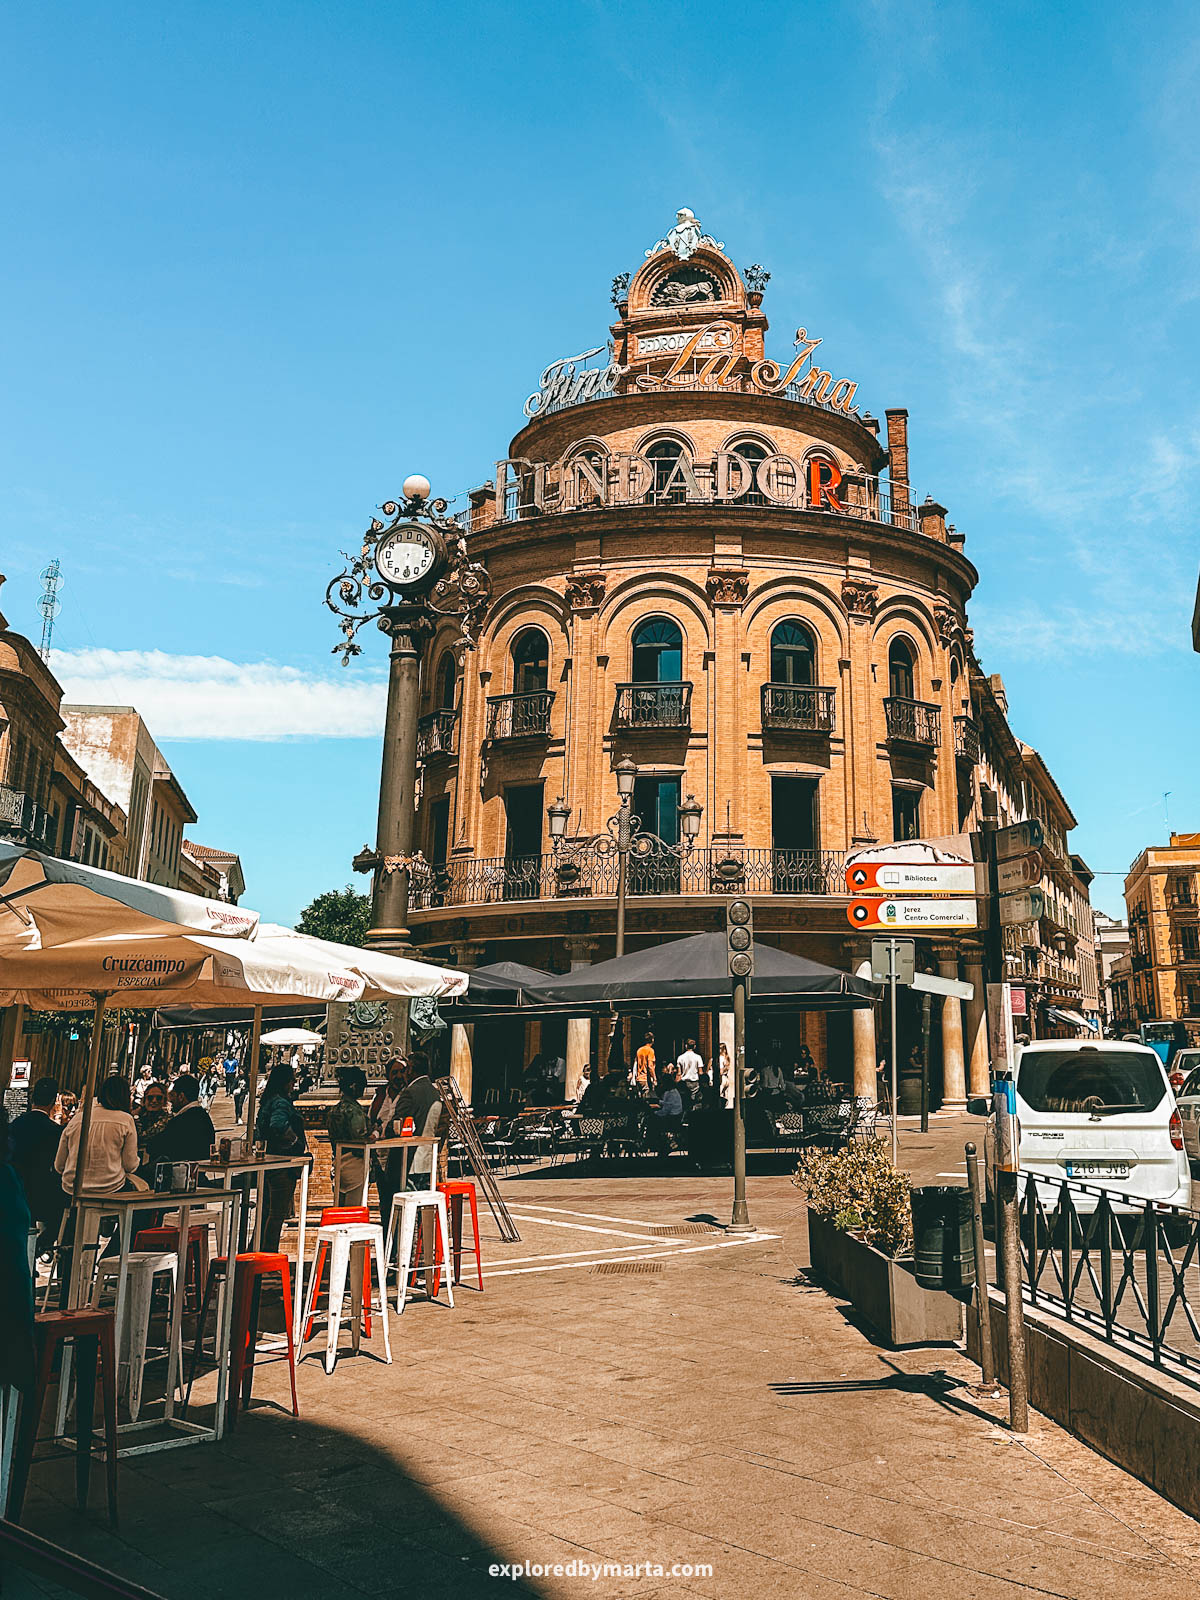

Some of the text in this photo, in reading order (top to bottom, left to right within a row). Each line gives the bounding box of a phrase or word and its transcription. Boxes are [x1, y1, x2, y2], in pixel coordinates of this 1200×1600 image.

[523, 345, 631, 417] Fino
[636, 320, 743, 387] La
[495, 450, 851, 521] FUNDADOR
[903, 906, 921, 914] Jerez
[102, 955, 185, 975] Cruzcampo
[117, 976, 165, 987] ESPECIAL
[338, 1031, 394, 1047] PEDRO
[1074, 1163, 1127, 1174] 2161 JVB
